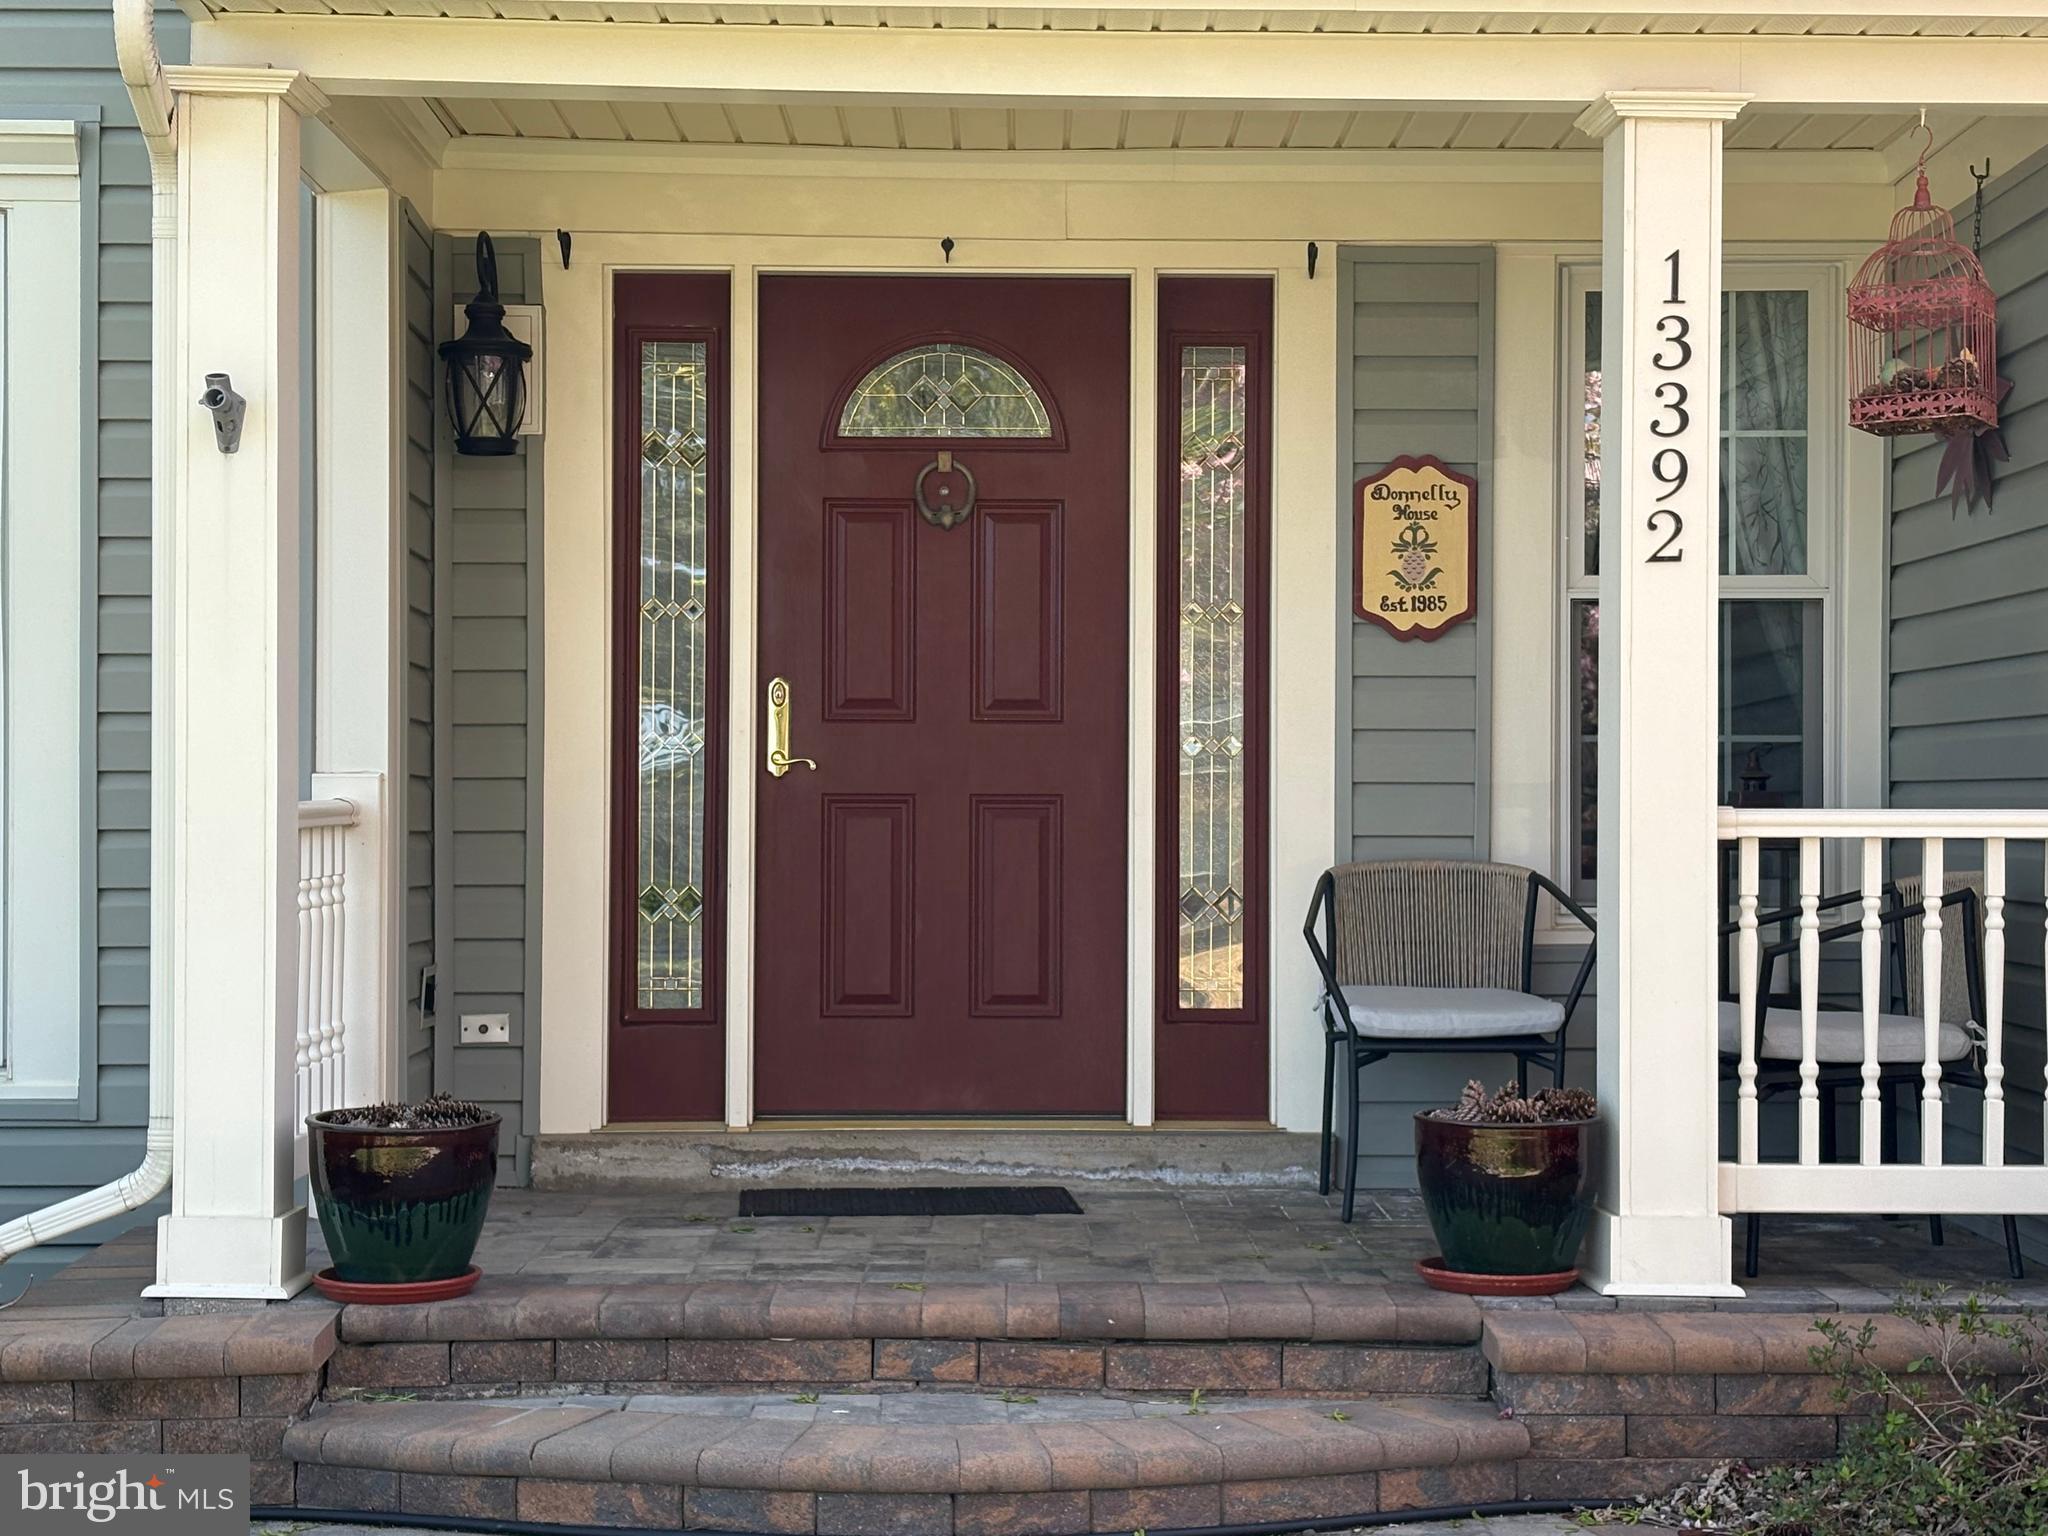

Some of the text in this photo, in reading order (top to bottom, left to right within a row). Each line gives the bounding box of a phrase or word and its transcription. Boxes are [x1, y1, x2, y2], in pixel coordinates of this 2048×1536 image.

[1645, 249, 1692, 564] 13392
[1370, 483, 1462, 511] Donnelly
[1392, 504, 1439, 521] House
[1411, 595, 1448, 613] 1985
